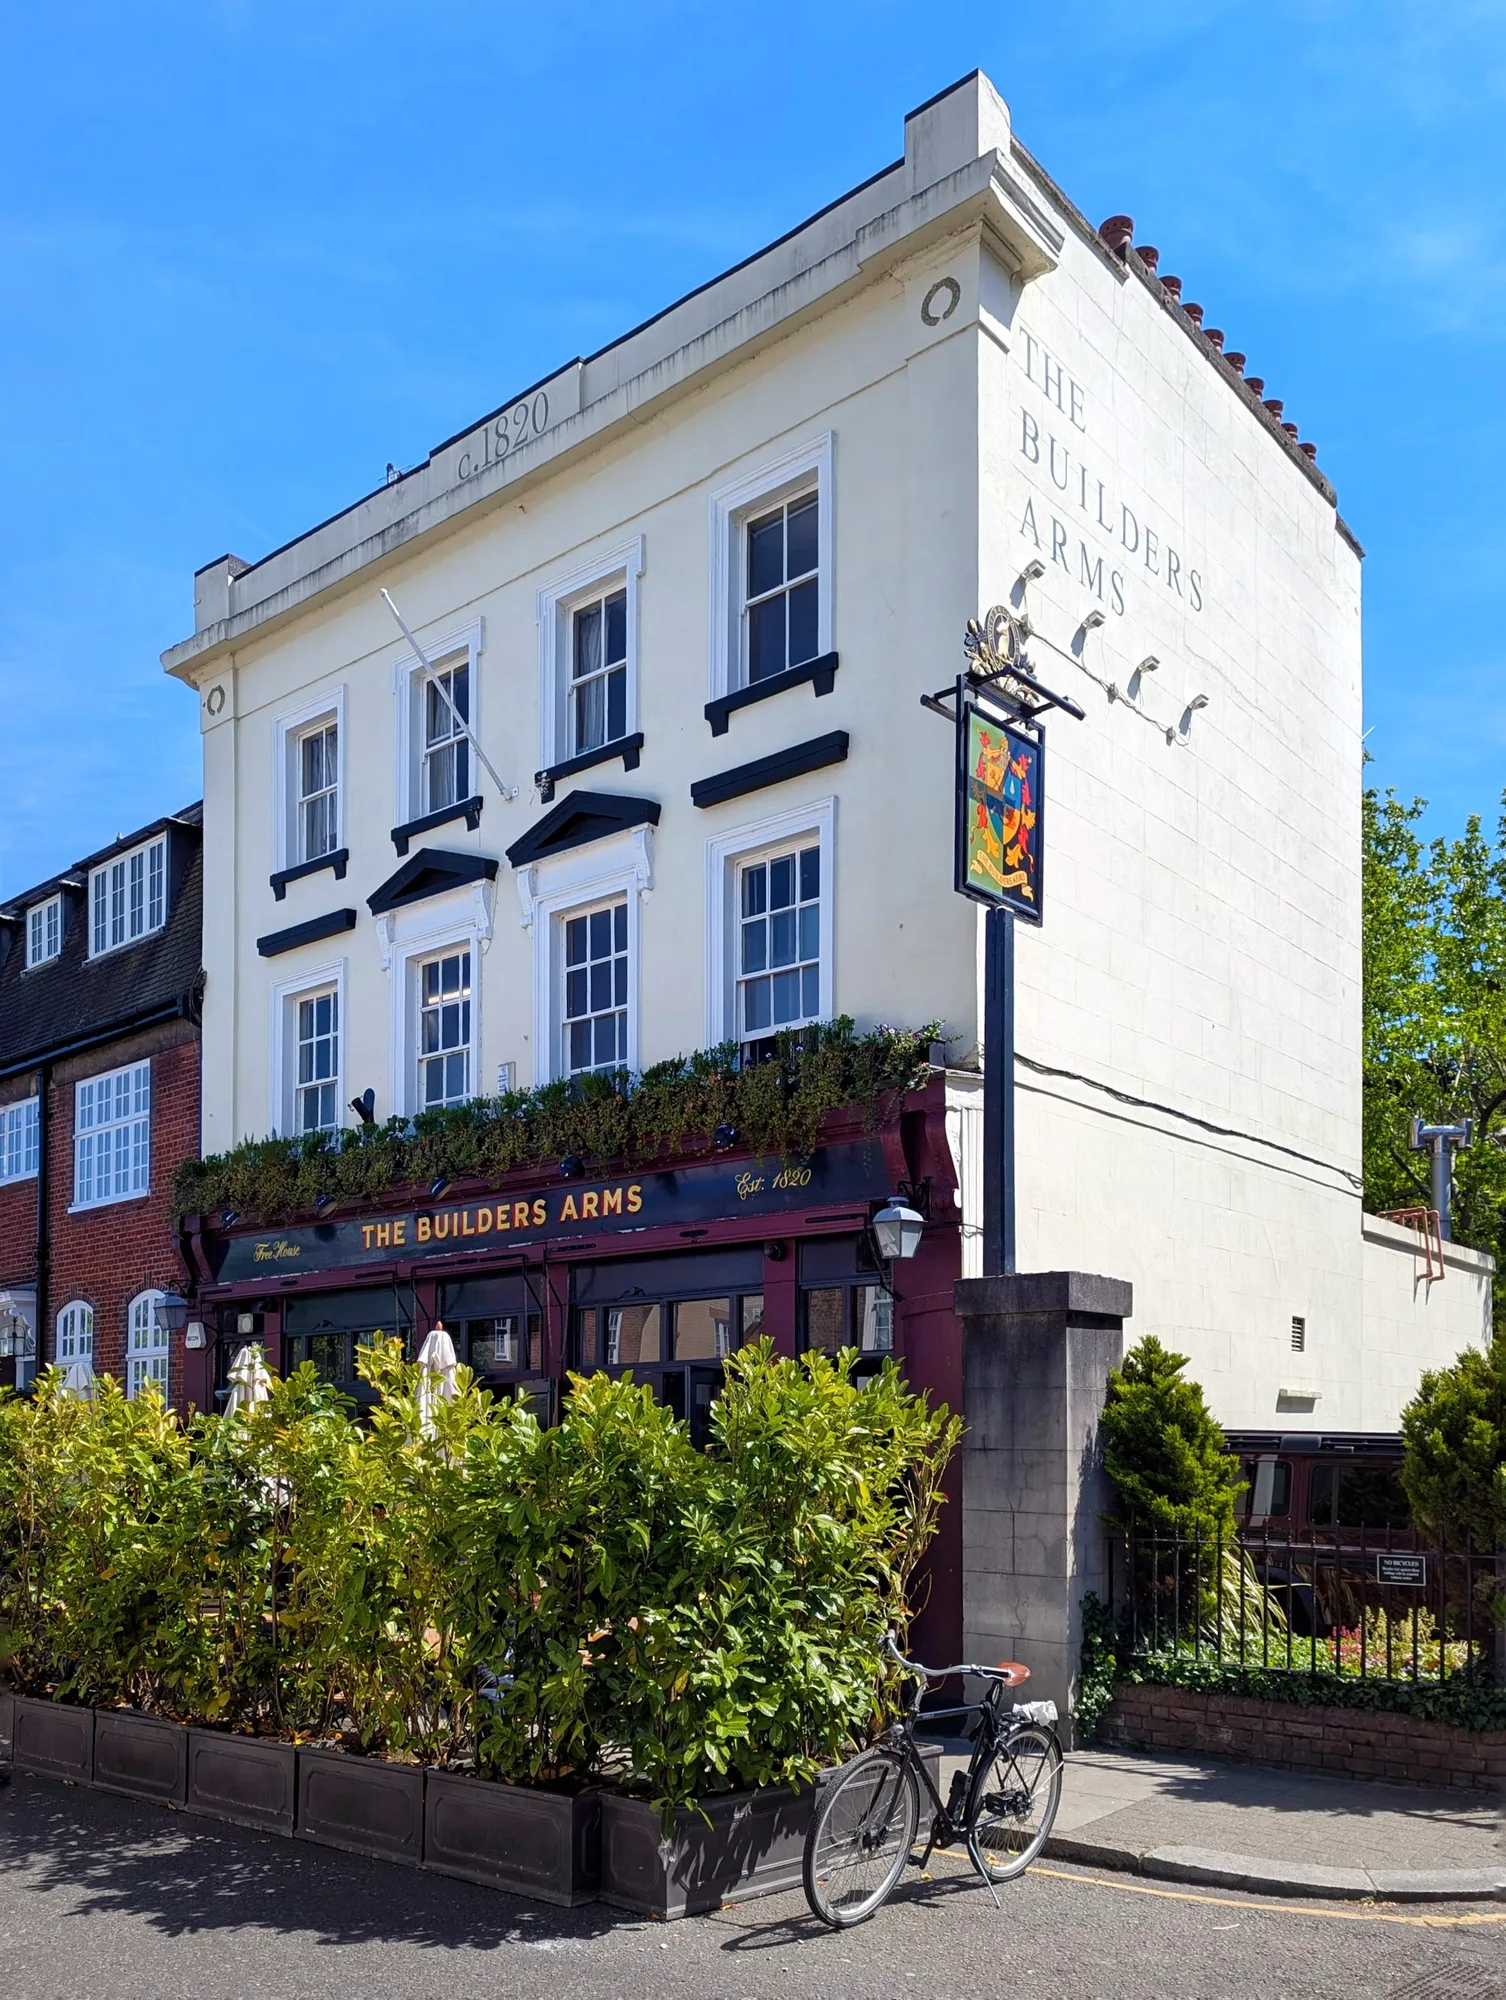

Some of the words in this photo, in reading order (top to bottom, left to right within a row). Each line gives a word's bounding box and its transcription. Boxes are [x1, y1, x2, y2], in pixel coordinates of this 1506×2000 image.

[1019, 325, 1086, 434] THE
[458, 391, 549, 481] c.1820
[1019, 404, 1203, 613] BUILDERS
[1019, 496, 1125, 617] ARMS
[361, 1220, 406, 1249] THE
[416, 1198, 547, 1242] BUILDERS
[559, 1184, 642, 1222] ARMS
[734, 1171, 765, 1200] Est.
[771, 1168, 811, 1189] 1820
[253, 1242, 273, 1263] Free
[272, 1241, 301, 1262] House
